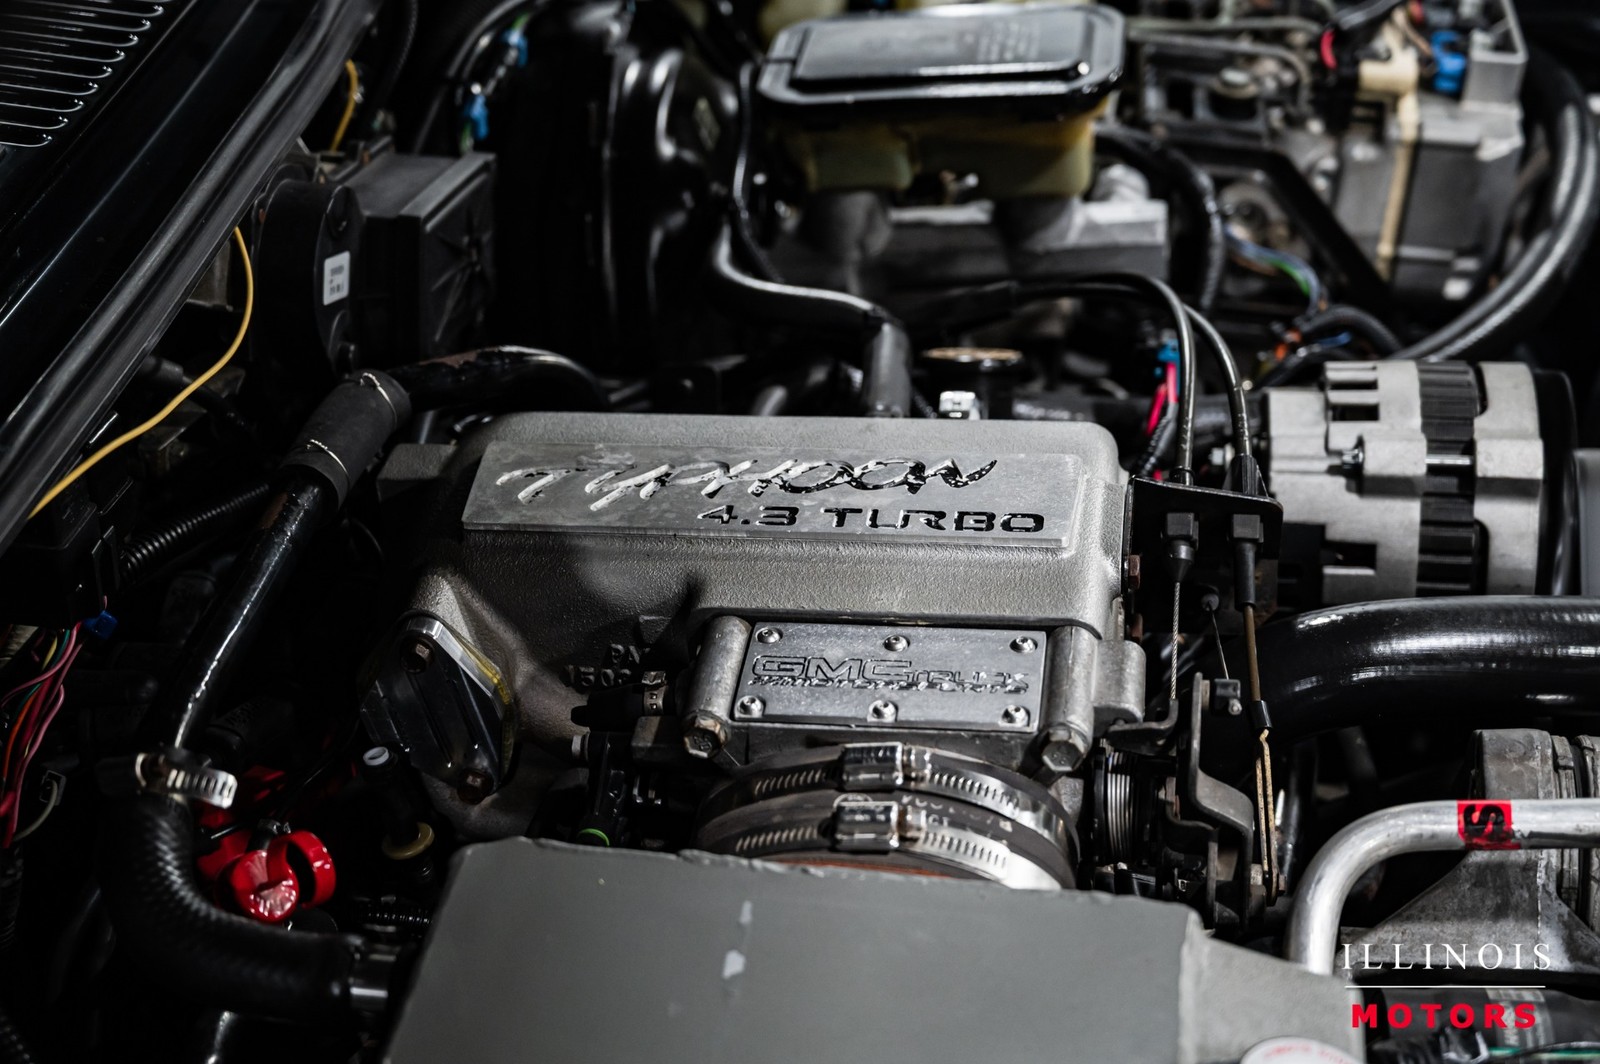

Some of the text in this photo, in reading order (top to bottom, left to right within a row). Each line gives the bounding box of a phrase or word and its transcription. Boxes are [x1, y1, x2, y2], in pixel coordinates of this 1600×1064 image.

[697, 504, 1045, 534] 4.3 TURBO
[752, 654, 913, 681] GMC
